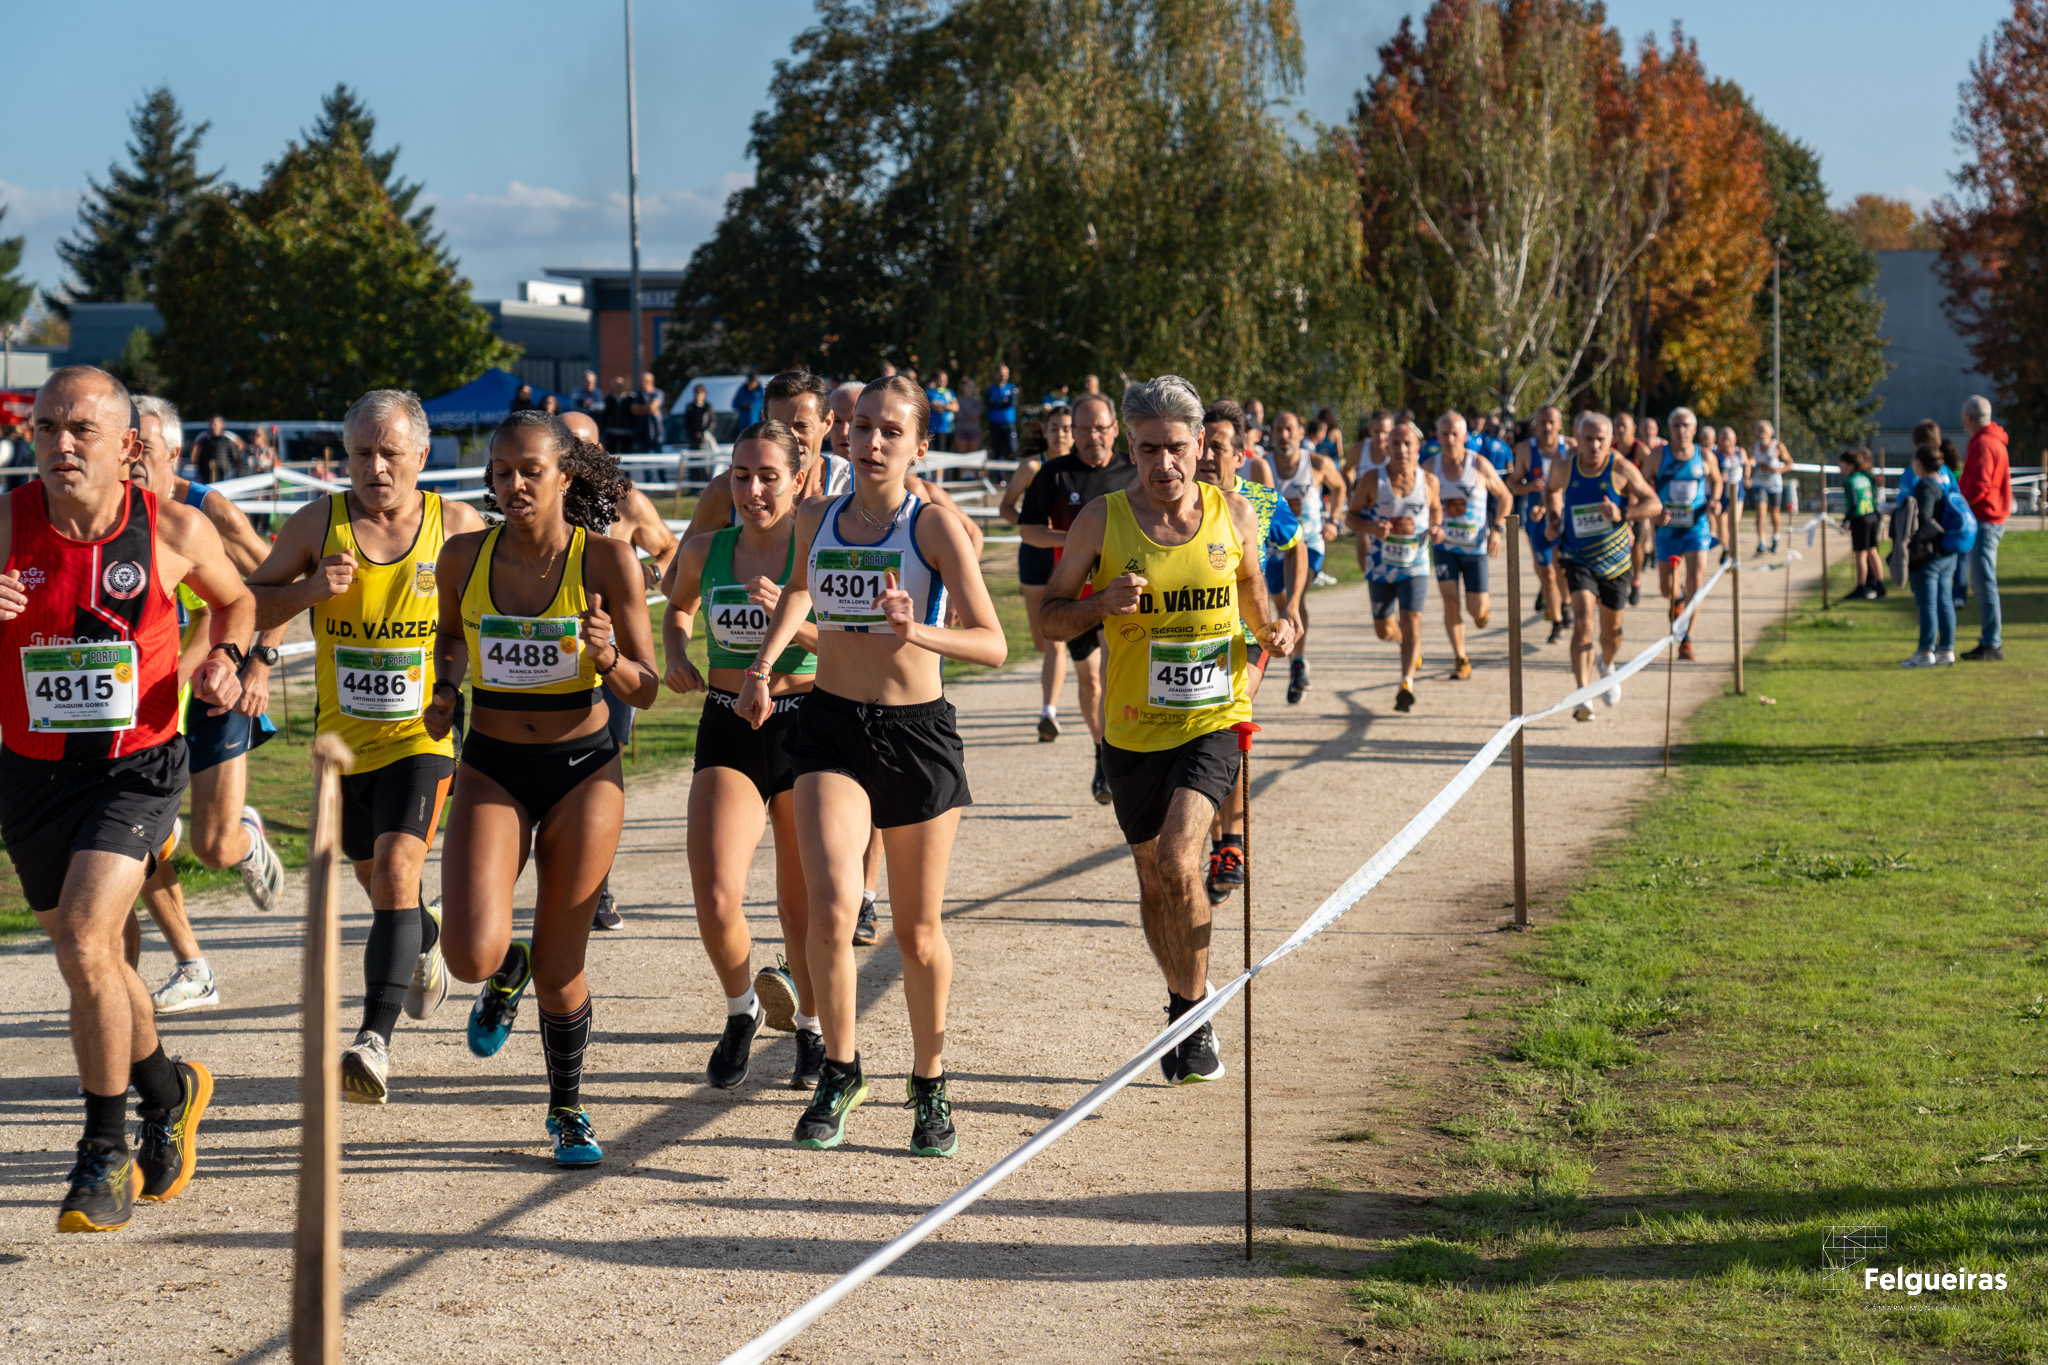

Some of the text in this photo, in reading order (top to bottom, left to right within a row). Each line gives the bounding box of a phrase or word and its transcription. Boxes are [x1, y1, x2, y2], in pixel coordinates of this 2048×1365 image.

[864, 554, 890, 566] PORTO
[820, 574, 879, 598] 4301
[1162, 585, 1230, 612] VÁRZEA
[326, 617, 357, 639] U.D.
[362, 617, 438, 639] VÁRZEA
[538, 623, 565, 636] PORTO
[1151, 621, 1231, 634] SÉRGIO F. DIAS
[90, 650, 119, 663] PORTO
[388, 655, 412, 666] PORTO
[487, 642, 559, 667] 4488
[1203, 644, 1221, 657] PORTO
[343, 672, 406, 696] 4486
[1157, 663, 1215, 686] 4507
[35, 675, 113, 701] 4815
